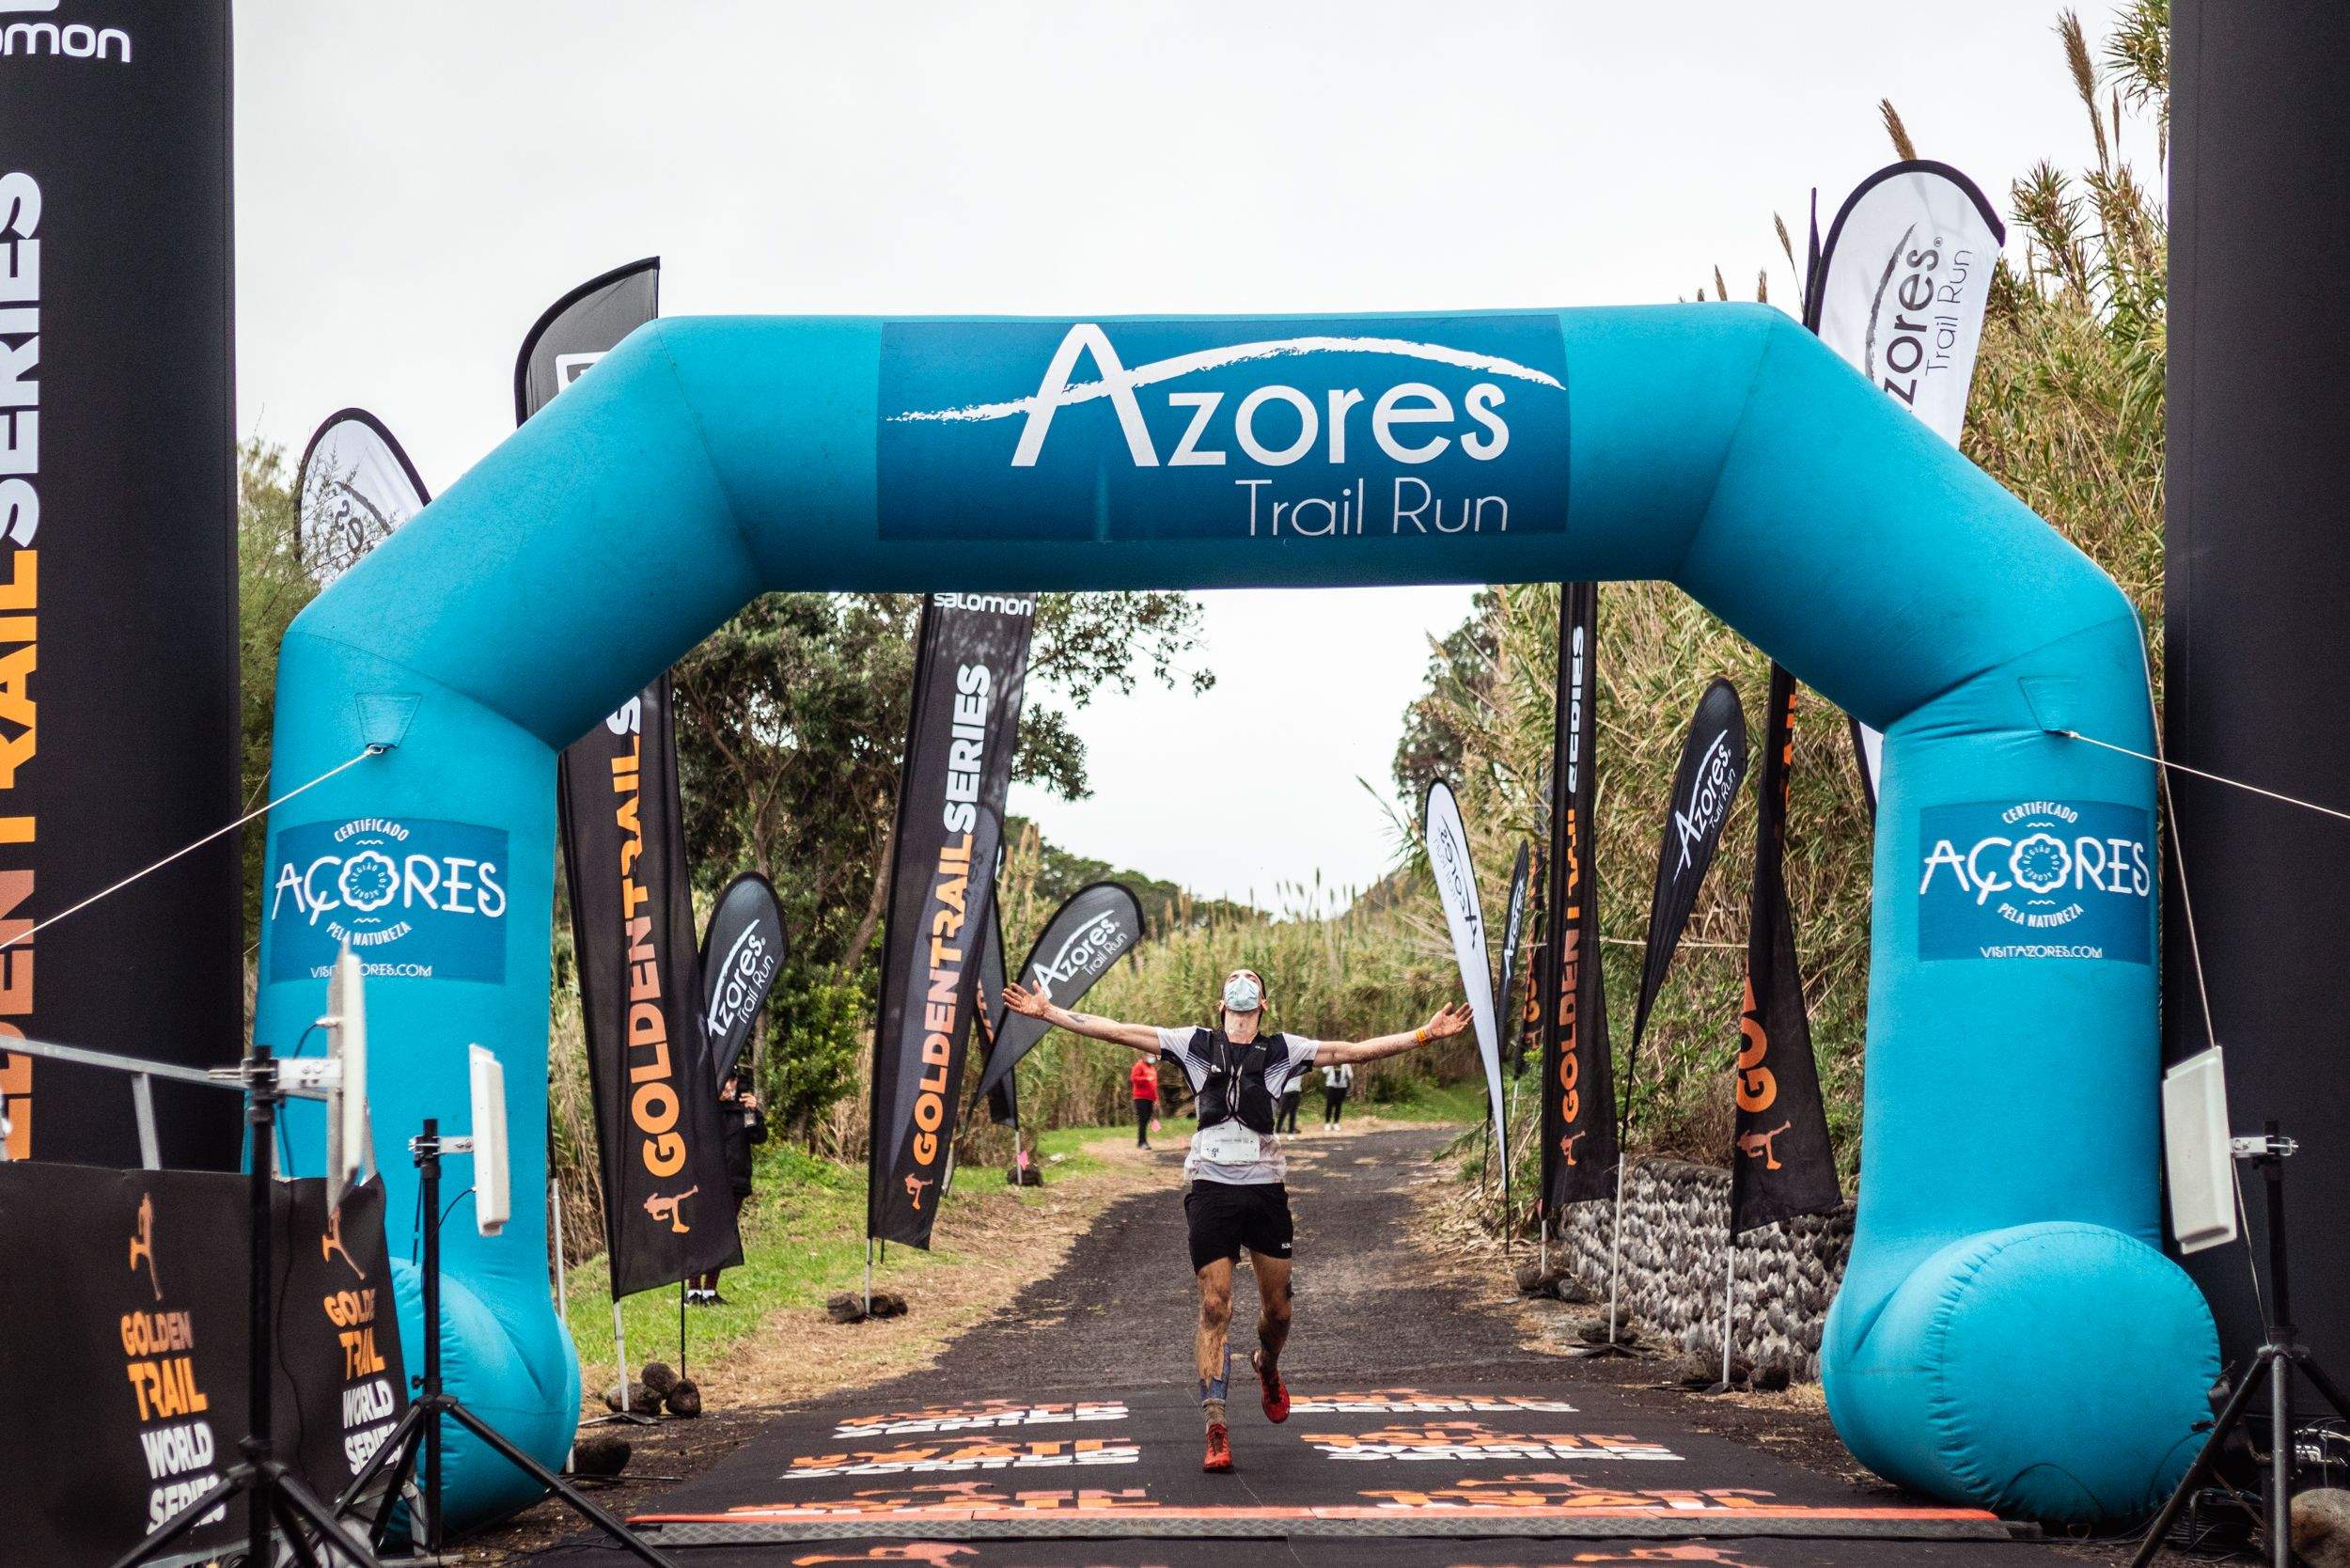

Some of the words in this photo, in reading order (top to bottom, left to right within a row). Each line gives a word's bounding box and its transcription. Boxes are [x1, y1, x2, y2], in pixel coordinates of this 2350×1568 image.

[1936, 249, 1973, 304] Run
[1926, 315, 1958, 376] Trail
[1011, 323, 1511, 467] Azores
[1235, 478, 1364, 536] Trail
[1393, 477, 1509, 535] Run
[933, 592, 1032, 617] salomon
[944, 663, 993, 834] SERIES
[334, 818, 410, 842] CERTIFICADO
[1674, 744, 1730, 870] Azores
[2001, 801, 2078, 824] CERTIFICADO
[271, 855, 507, 927] AÇORES
[1919, 833, 2151, 906] AÇORES
[325, 921, 351, 943] PELA
[352, 920, 413, 947] NATUREZA
[1997, 902, 2025, 926] PELA
[2027, 902, 2085, 929] NATUREZA
[310, 964, 433, 979] VISIORES.COM
[752, 954, 776, 991] Run
[1032, 917, 1117, 1000] Azores
[1081, 949, 1109, 977] Trail
[1103, 932, 1129, 956] Run
[1980, 945, 2103, 959] VISITAZORES.COM
[120, 1311, 194, 1356] GOLDEN
[127, 1356, 209, 1421] TRAIL
[342, 1379, 395, 1429] WORLD
[141, 1421, 214, 1480] WORLD
